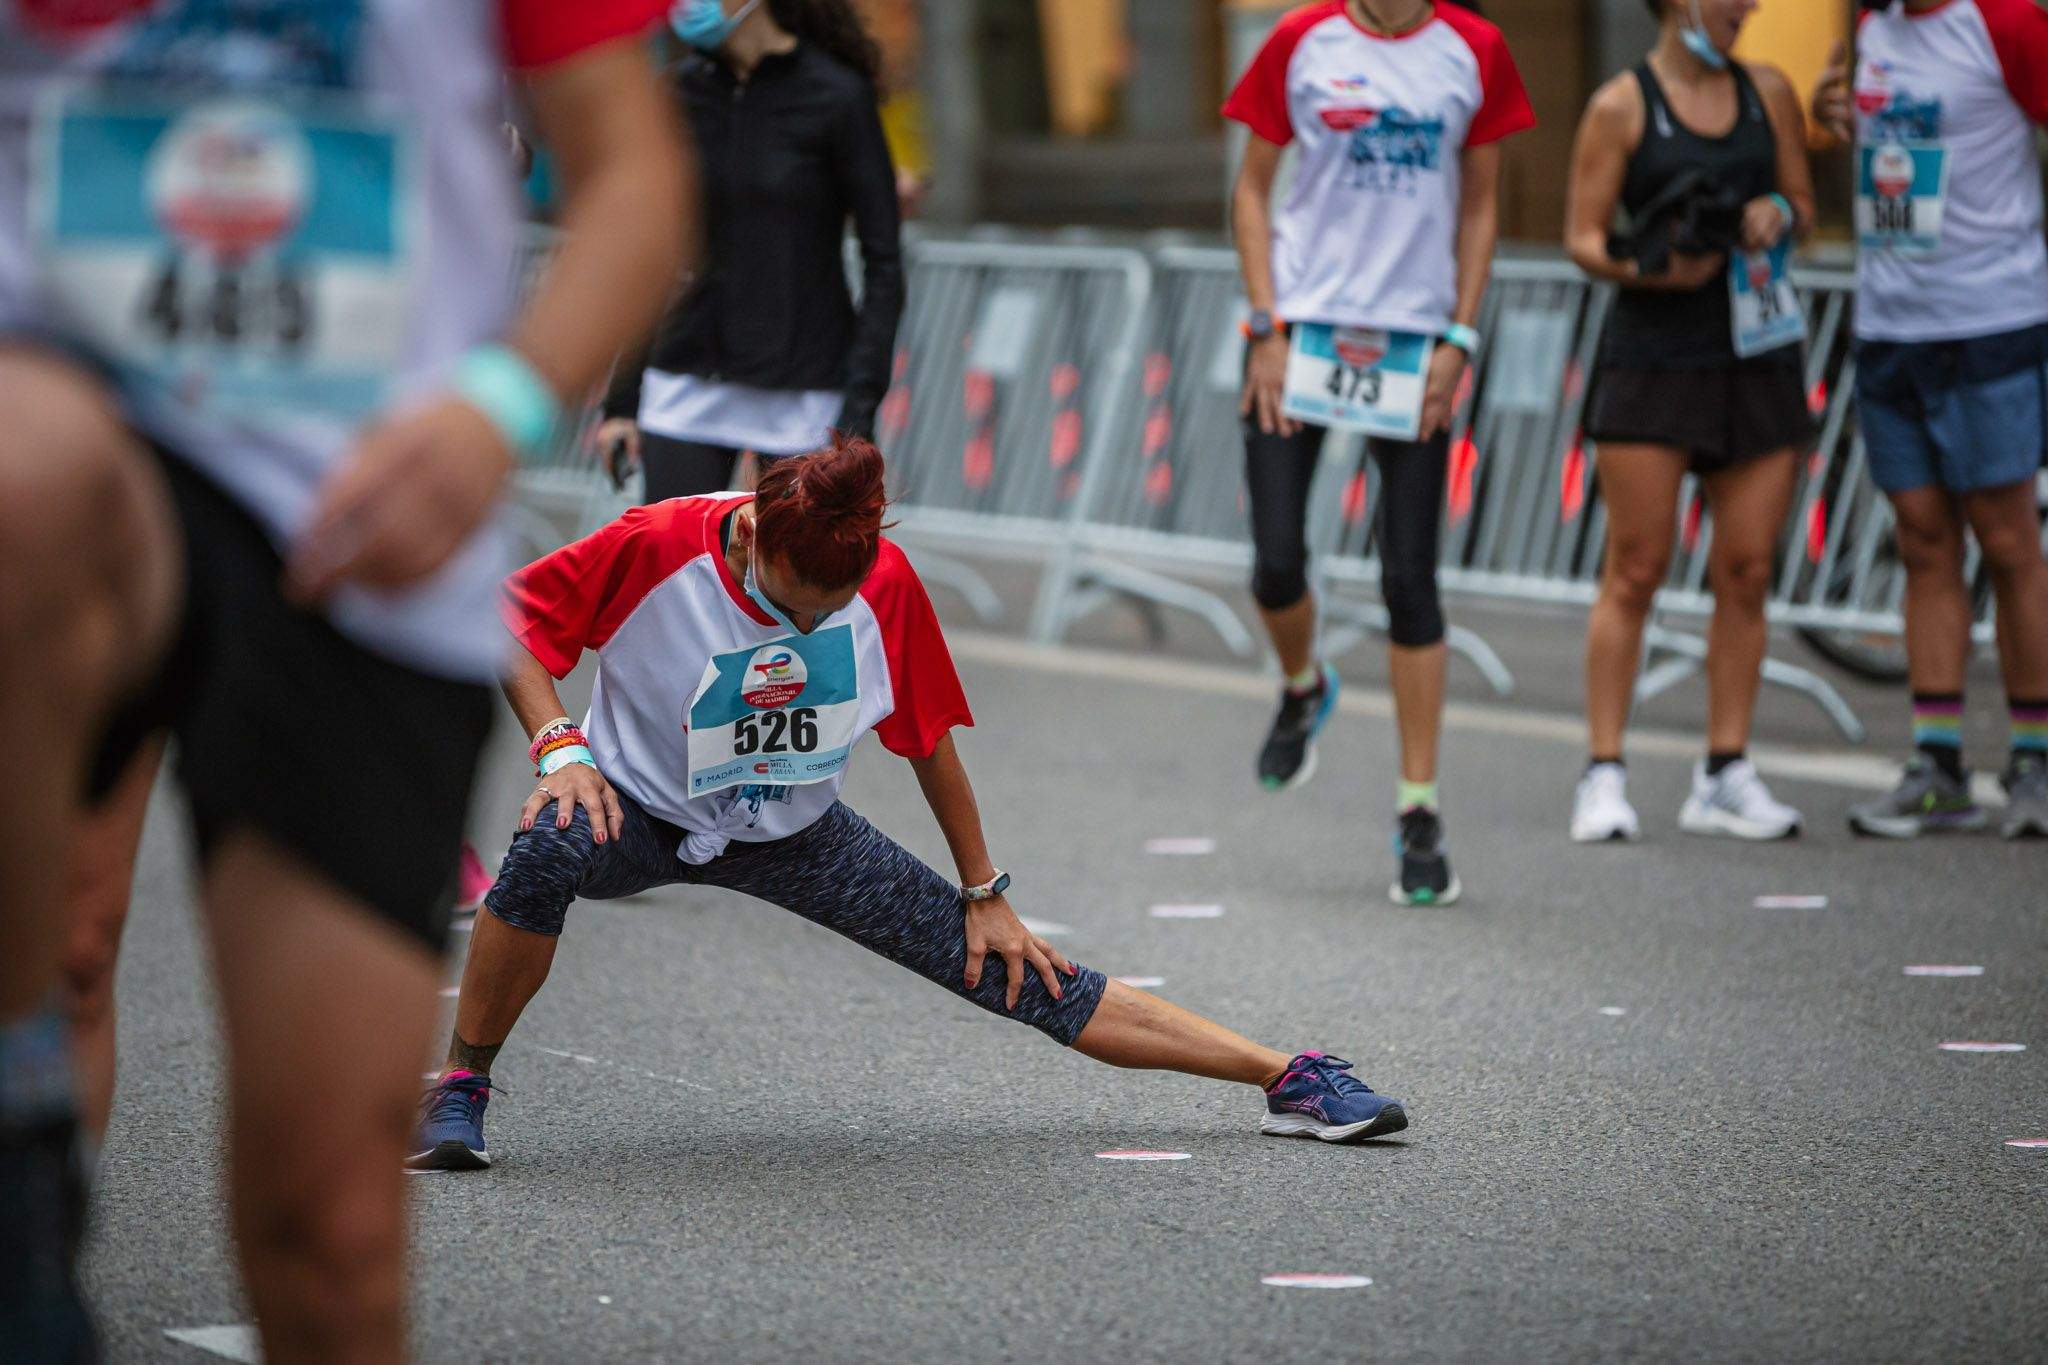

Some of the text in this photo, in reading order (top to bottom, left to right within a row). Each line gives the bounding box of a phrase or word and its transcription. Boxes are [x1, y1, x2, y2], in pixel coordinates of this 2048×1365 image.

[1325, 361, 1382, 405] 473
[764, 695, 791, 704] MADRID
[734, 707, 818, 756] 526
[706, 766, 744, 782] MADRID
